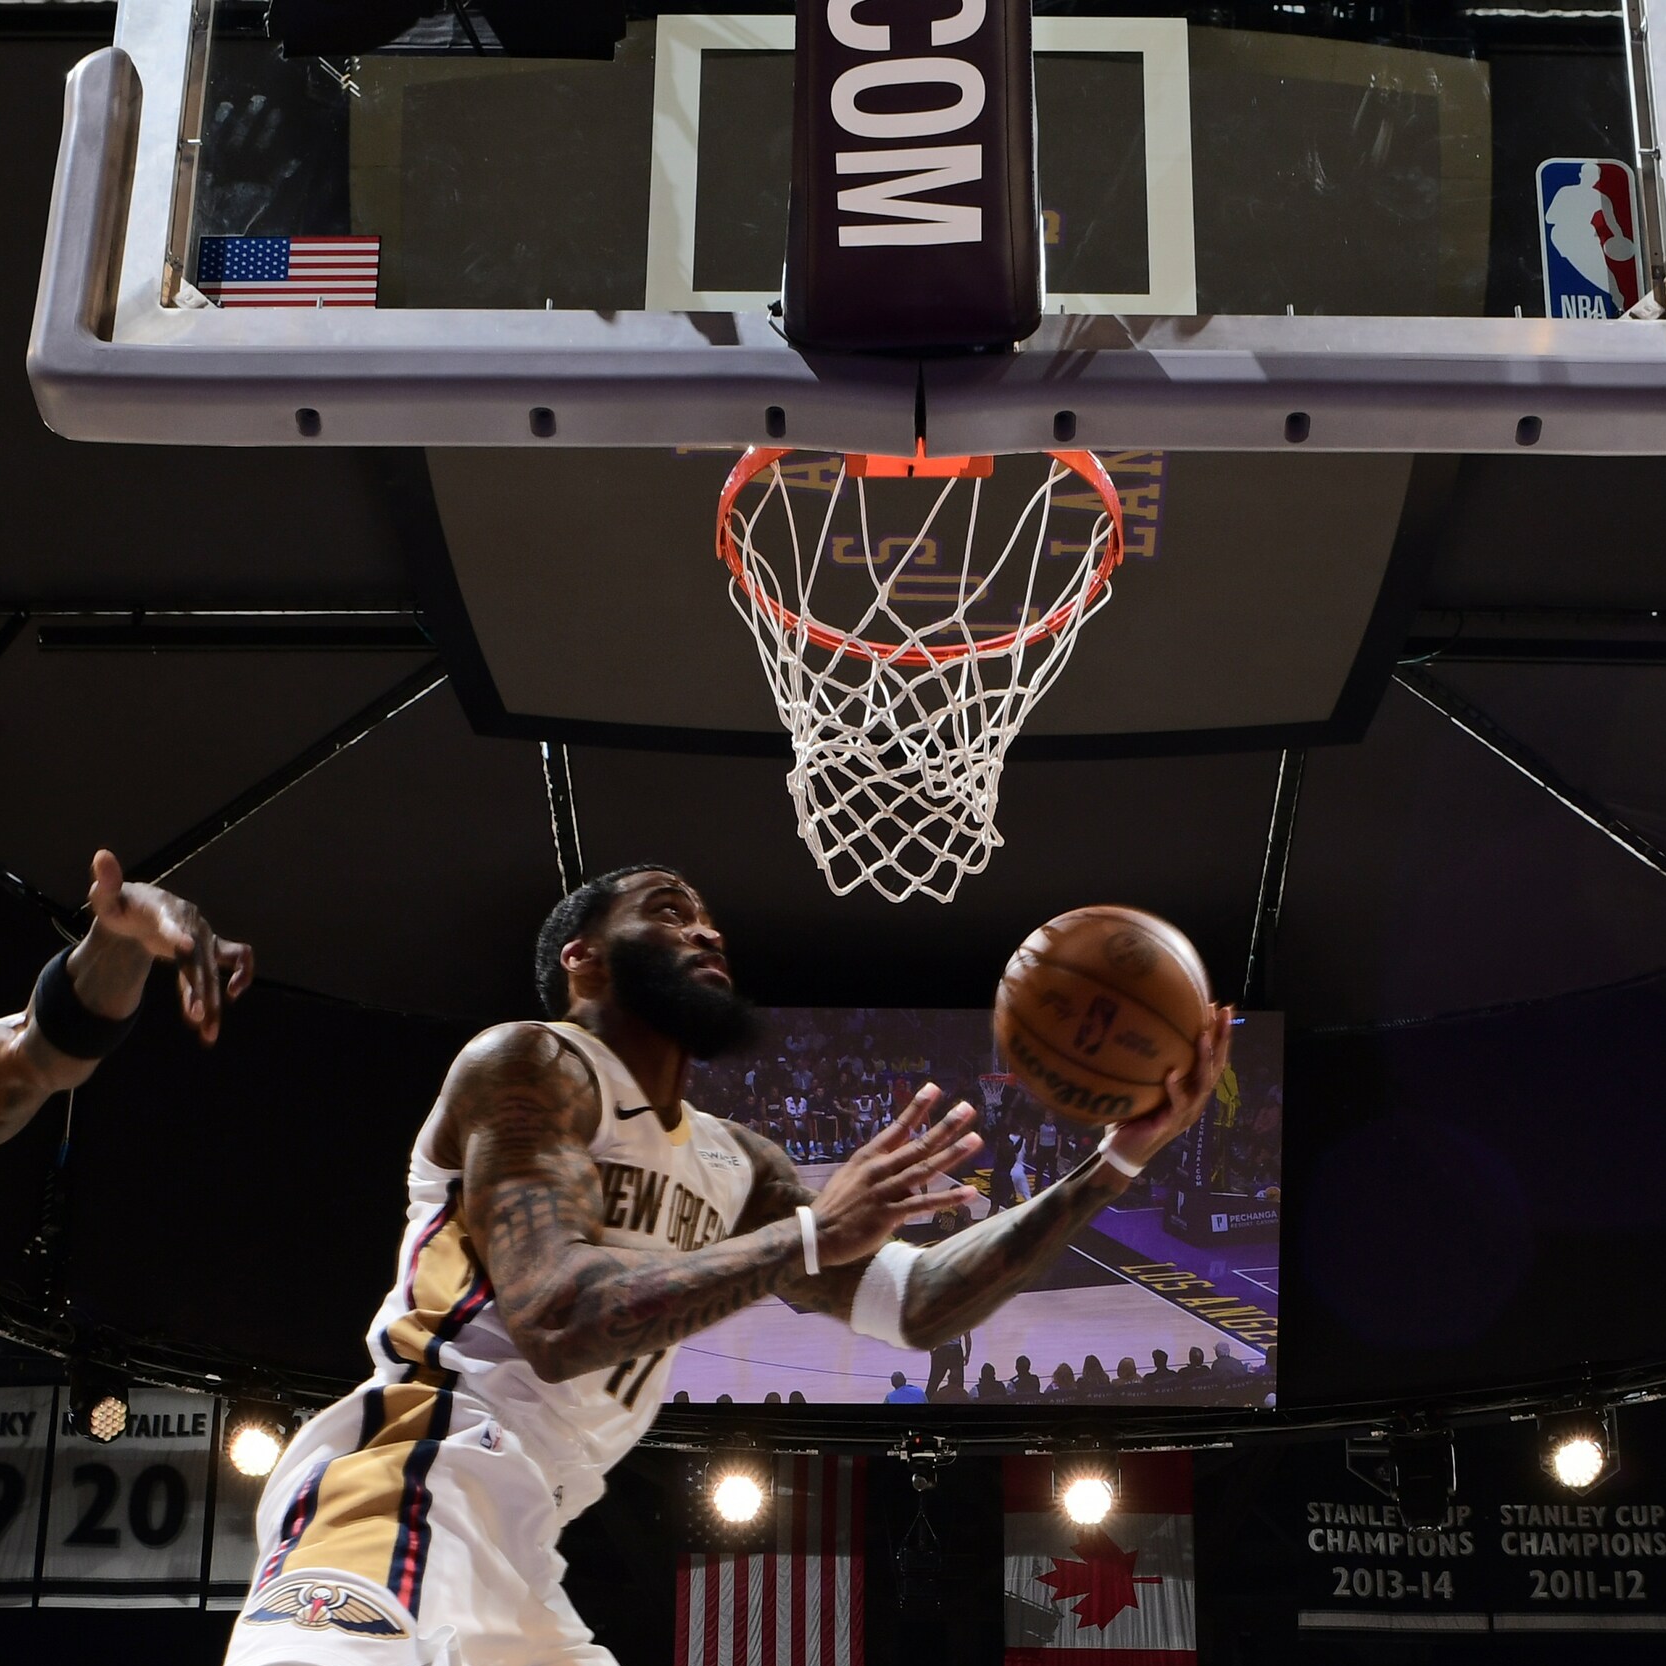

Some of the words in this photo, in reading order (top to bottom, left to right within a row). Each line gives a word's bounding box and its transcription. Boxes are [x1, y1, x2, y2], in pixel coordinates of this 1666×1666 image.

[830, 0, 985, 248] COM
[1560, 294, 1604, 321] NBA
[1230, 1211, 1277, 1223] PECHANGA
[1120, 1261, 1215, 1292] LOS
[63, 1464, 189, 1548] 20
[1307, 1502, 1406, 1526] STANLE
[1501, 1504, 1611, 1528] STANLEY
[1615, 1506, 1666, 1528] CUP
[1308, 1528, 1476, 1557] CHAMPIONS
[1332, 1567, 1454, 1600] 2013-14
[1530, 1571, 1648, 1600] 2011-12
